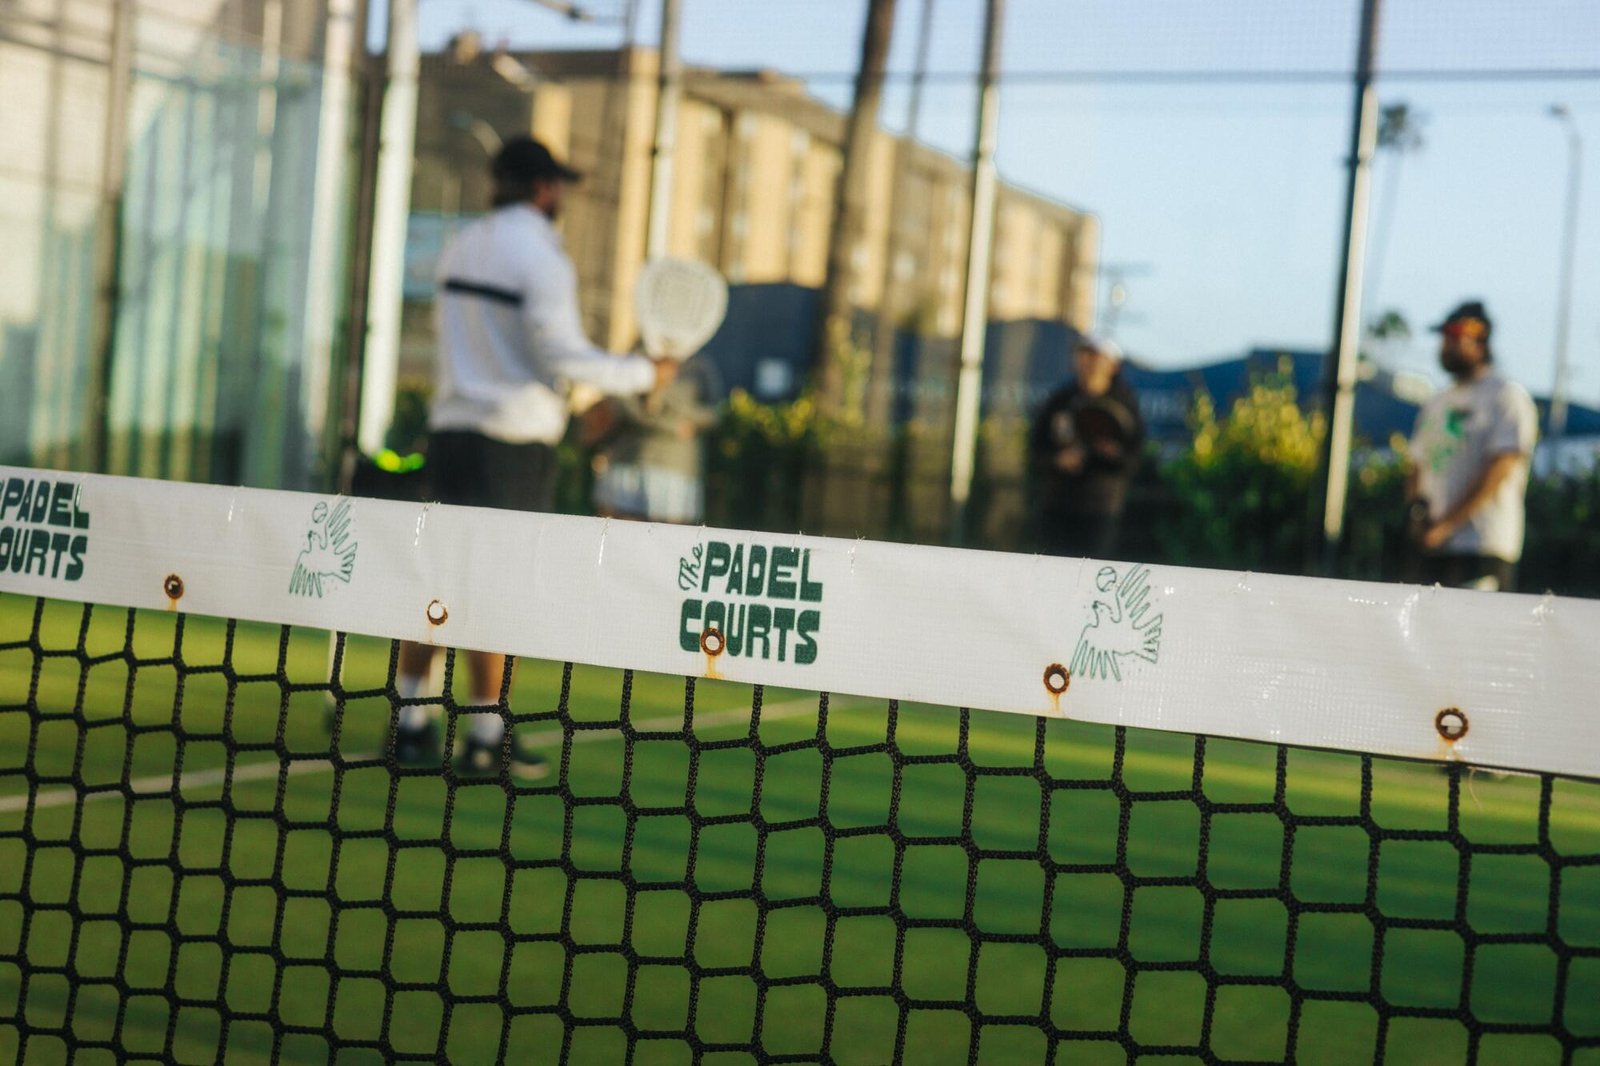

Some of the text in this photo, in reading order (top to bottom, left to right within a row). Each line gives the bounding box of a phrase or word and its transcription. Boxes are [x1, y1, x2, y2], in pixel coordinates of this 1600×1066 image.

[0, 477, 90, 530] PADEL
[0, 526, 89, 582] OURTS
[678, 541, 823, 602] The PADEL
[679, 598, 821, 665] COURTS
